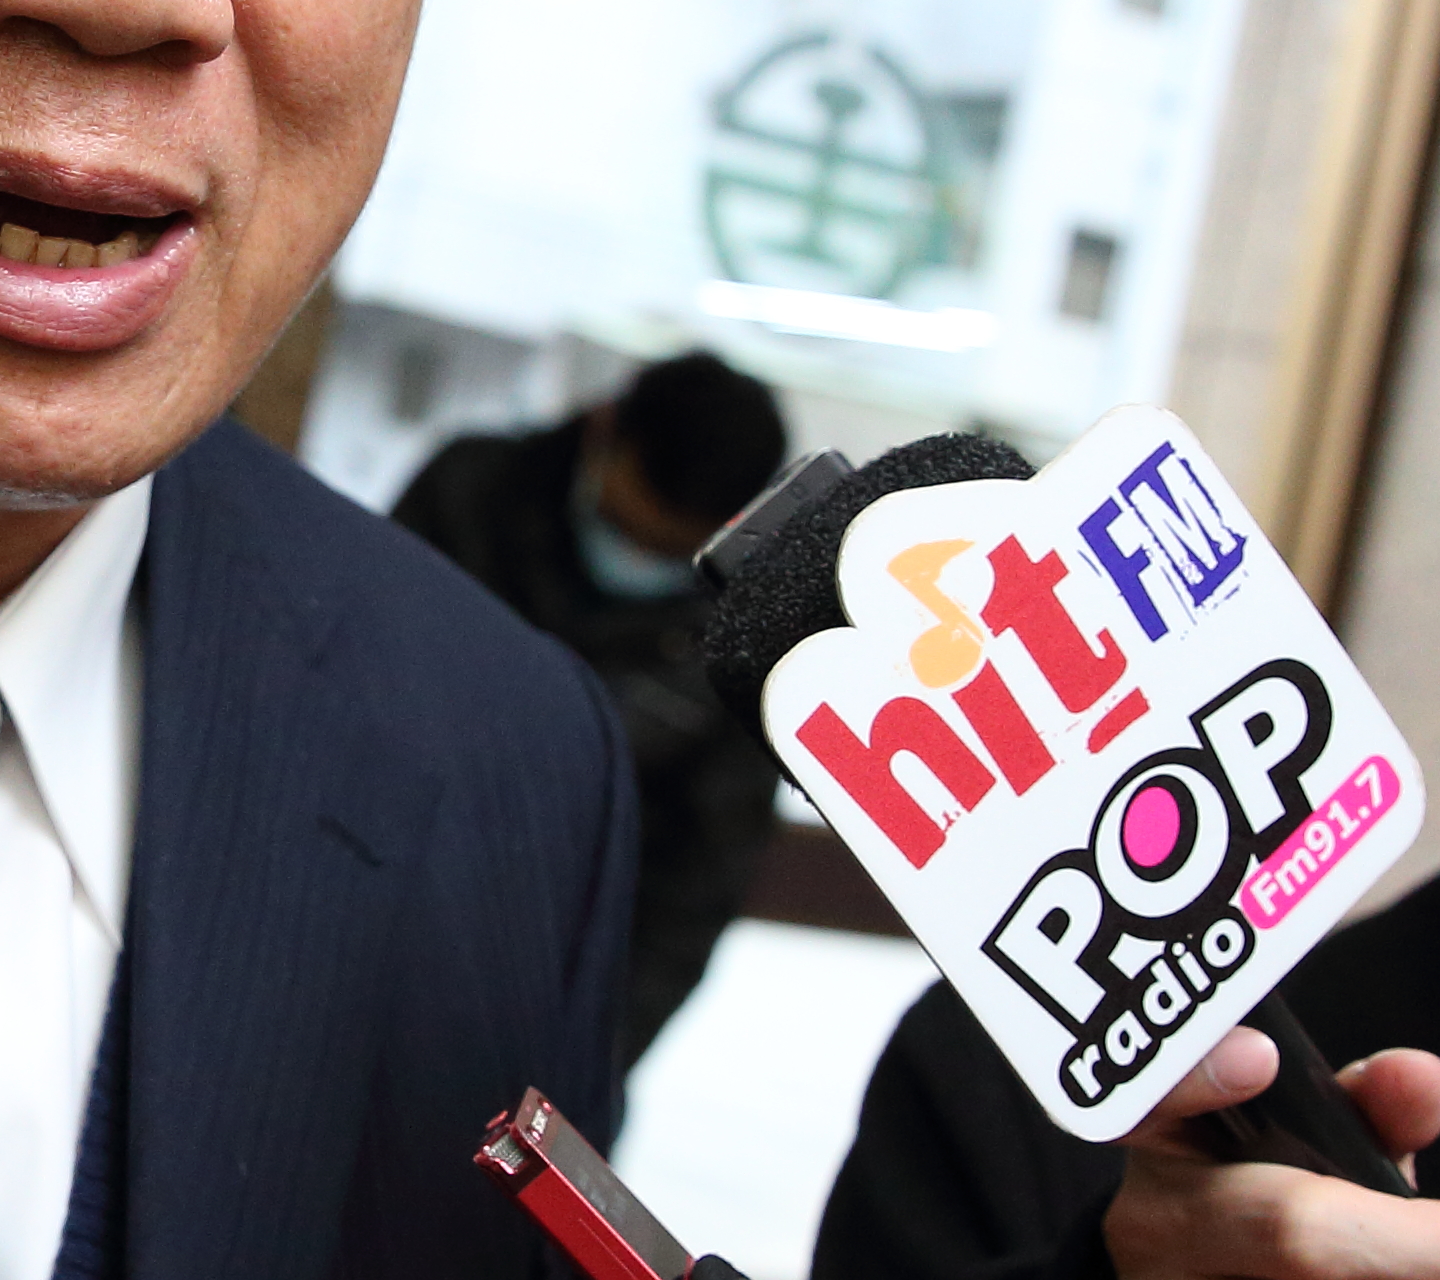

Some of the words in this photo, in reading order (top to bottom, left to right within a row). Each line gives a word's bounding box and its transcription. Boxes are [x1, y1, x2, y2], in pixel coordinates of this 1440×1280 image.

[795, 533, 1128, 871] hit
[1077, 441, 1247, 643] FM
[981, 658, 1333, 1028] POP
[1249, 766, 1388, 920] Fm91.7
[1062, 915, 1251, 1105] radio
